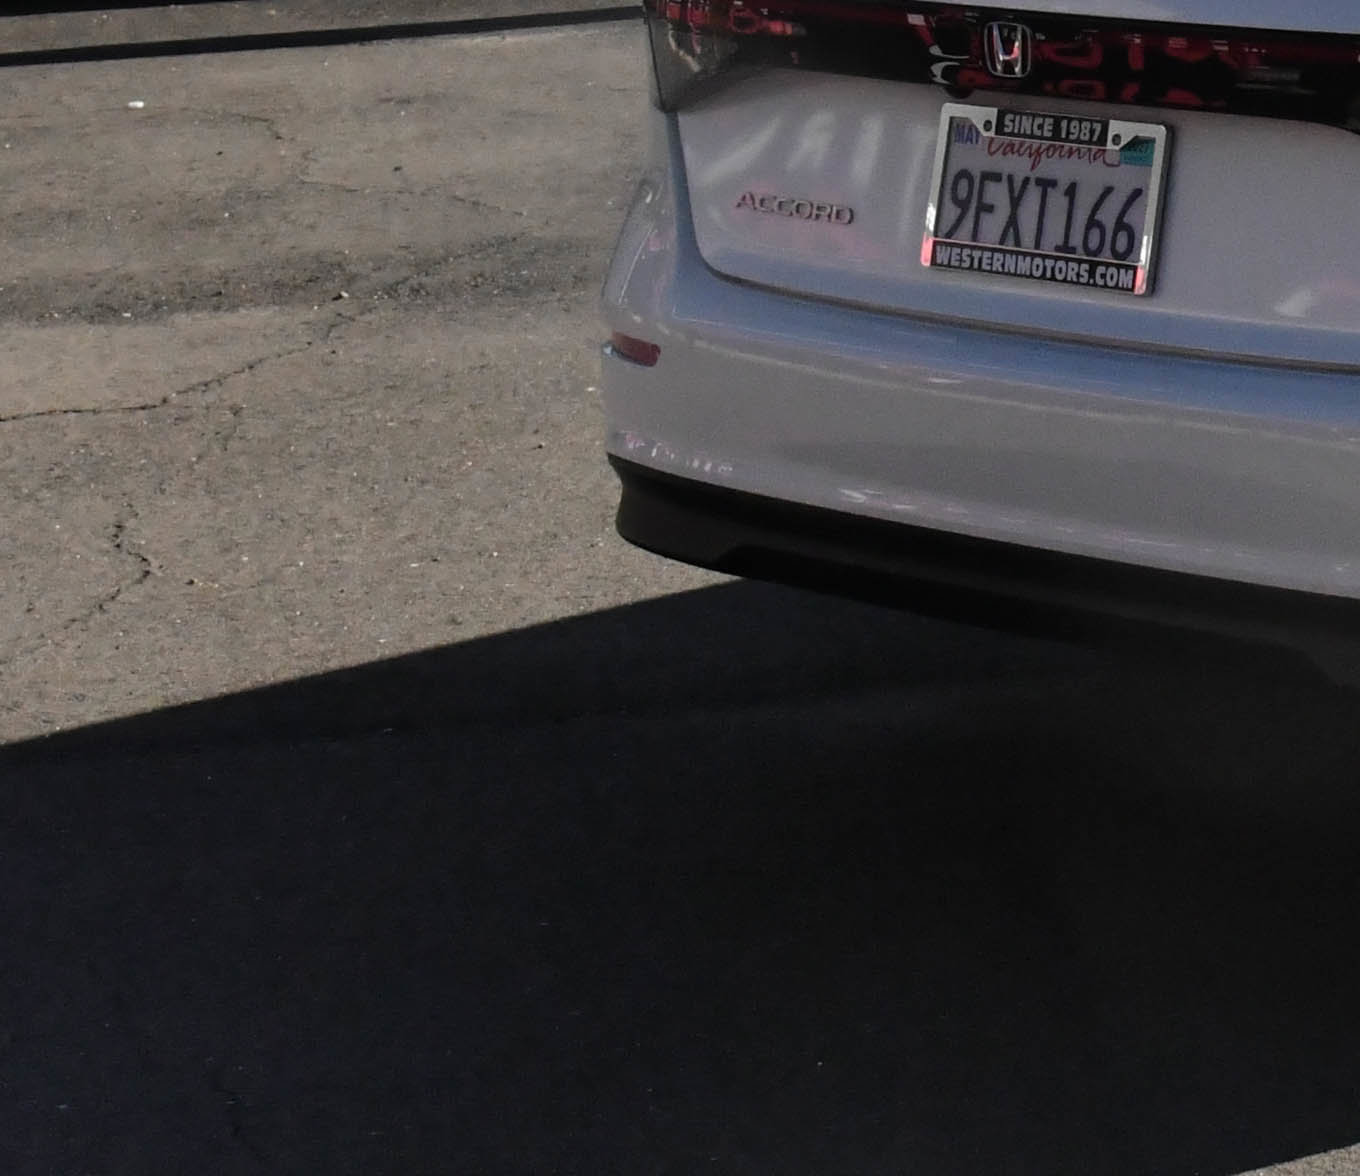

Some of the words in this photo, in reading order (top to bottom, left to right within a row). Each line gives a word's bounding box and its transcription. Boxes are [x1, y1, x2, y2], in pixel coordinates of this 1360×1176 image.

[1003, 113, 1053, 140] SINCE
[1060, 119, 1102, 142] 1987
[736, 191, 855, 225] ACCORD
[944, 168, 1144, 261] 9FXT166
[935, 244, 1133, 289] WESTERNMOTORS.COM
